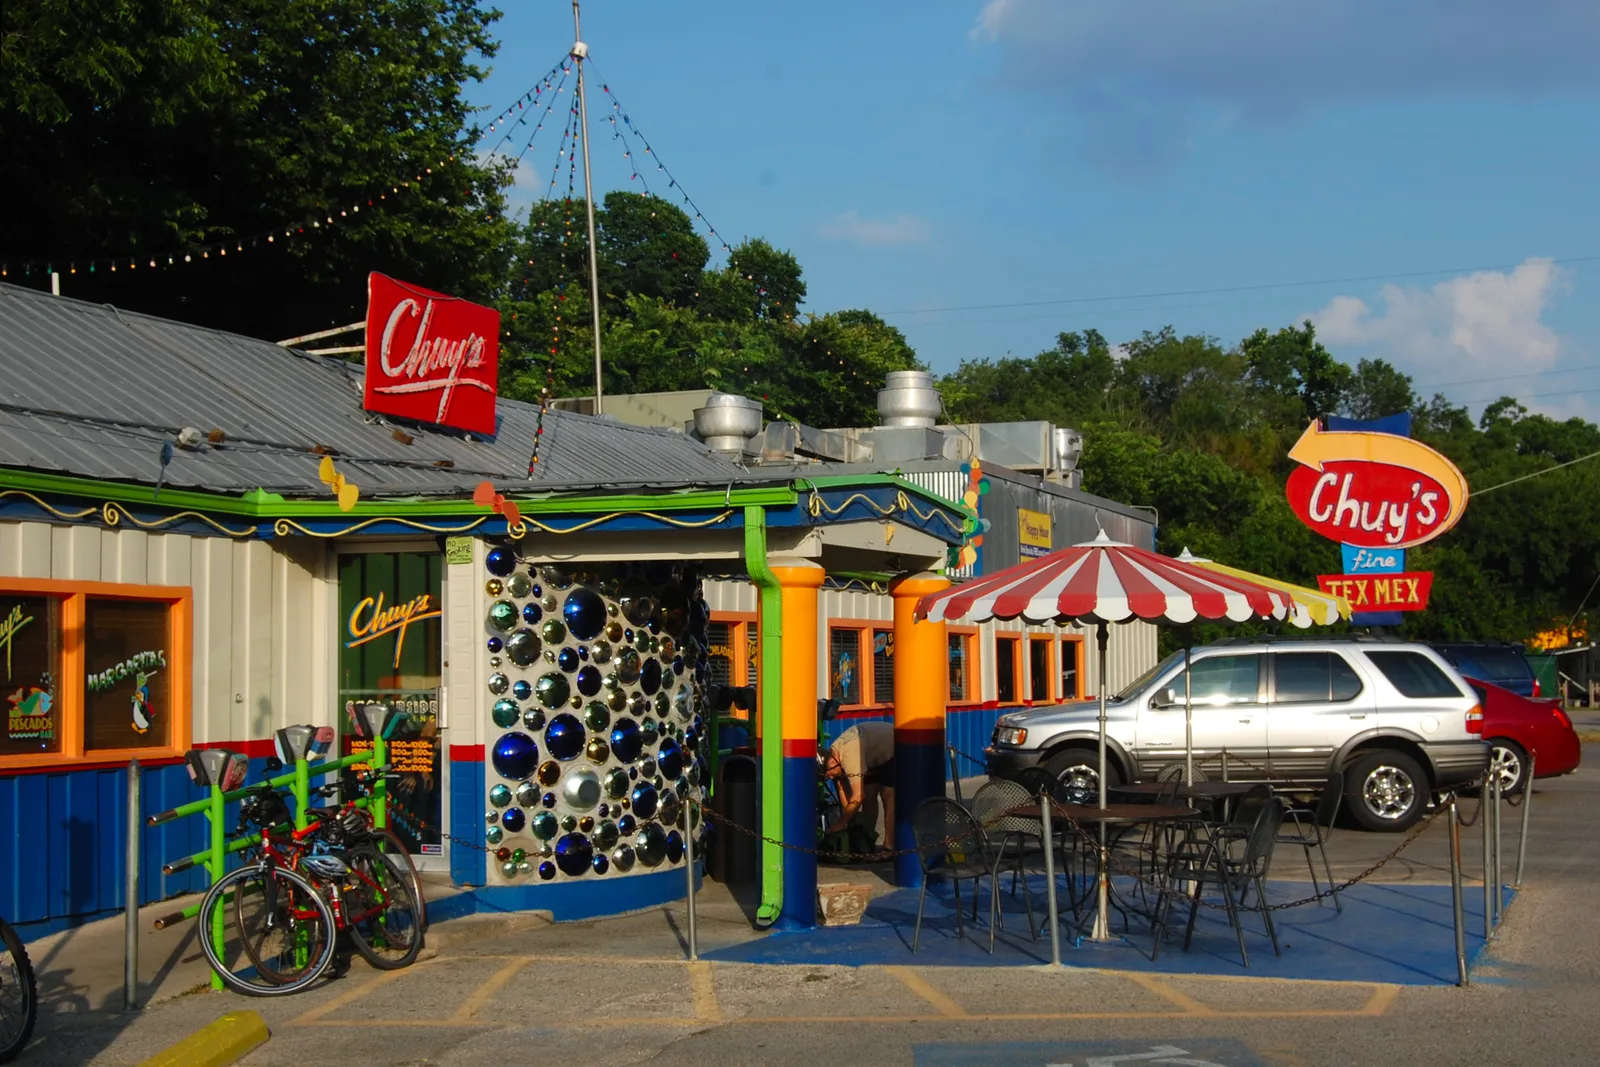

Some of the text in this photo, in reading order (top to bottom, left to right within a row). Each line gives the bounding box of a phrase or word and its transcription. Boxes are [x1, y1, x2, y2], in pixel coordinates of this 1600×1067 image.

[374, 298, 496, 424] Chuy's
[1308, 472, 1438, 544] Chuy's
[1350, 549, 1397, 572] fine
[1325, 578, 1420, 605] TEX MEX
[346, 591, 442, 668] Chuy's
[87, 649, 167, 692] MARGARITAS
[9, 717, 53, 731] PESCADOS
